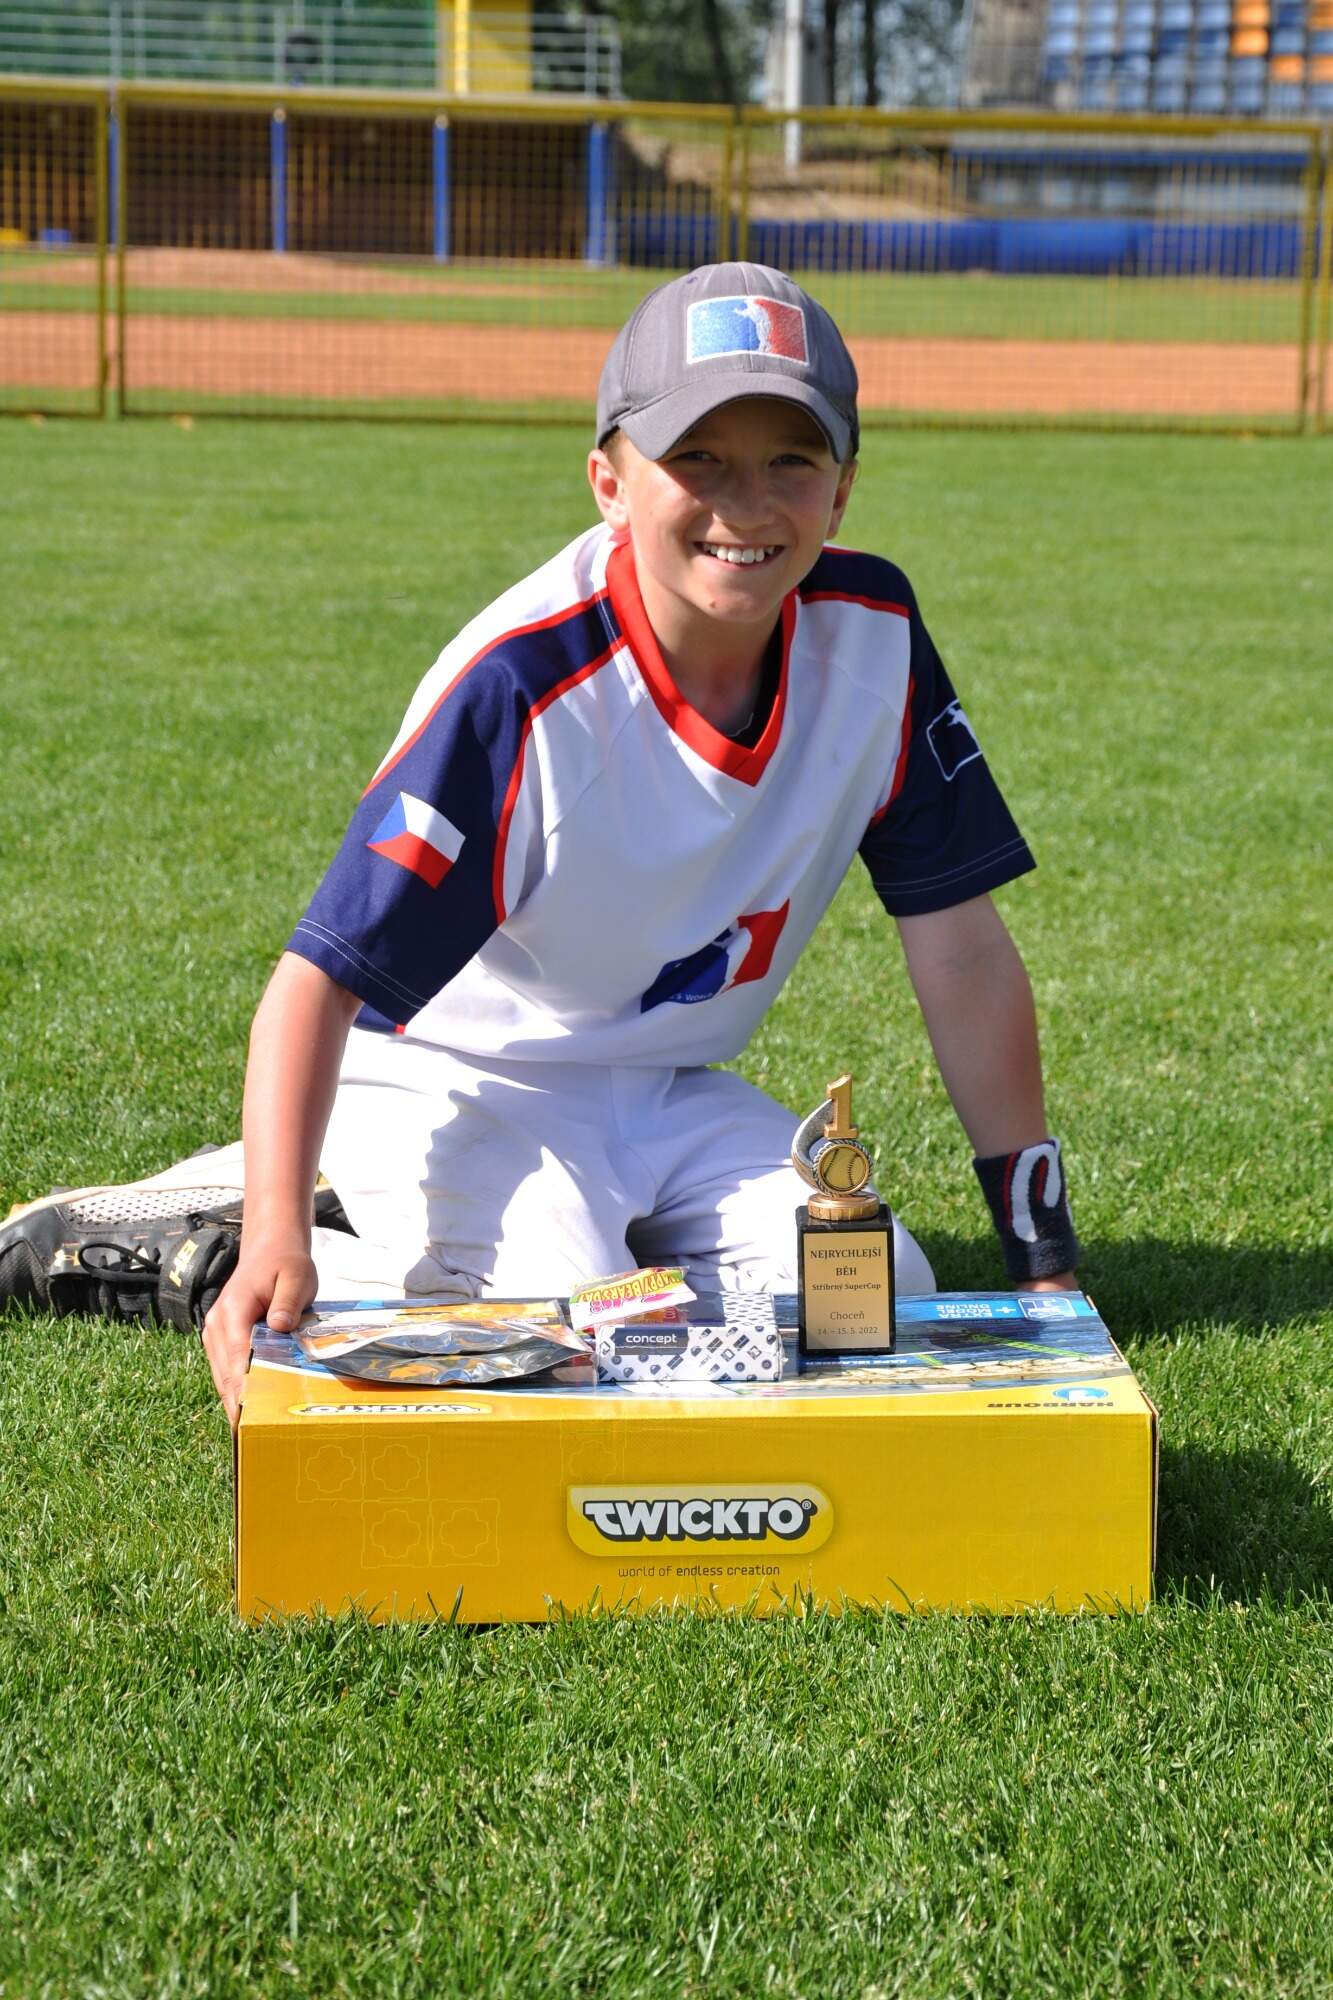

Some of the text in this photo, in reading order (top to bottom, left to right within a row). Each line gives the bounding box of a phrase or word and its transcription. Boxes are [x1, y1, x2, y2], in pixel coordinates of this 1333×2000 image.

[810, 1247, 882, 1259] NEJRYCHLEJŠÍ
[836, 1265, 857, 1277] BĚH
[844, 1282, 882, 1292] SuperCup
[830, 1311, 865, 1320] Choceň
[625, 1333, 678, 1345] concept
[618, 1564, 780, 1578] world of endless creation
